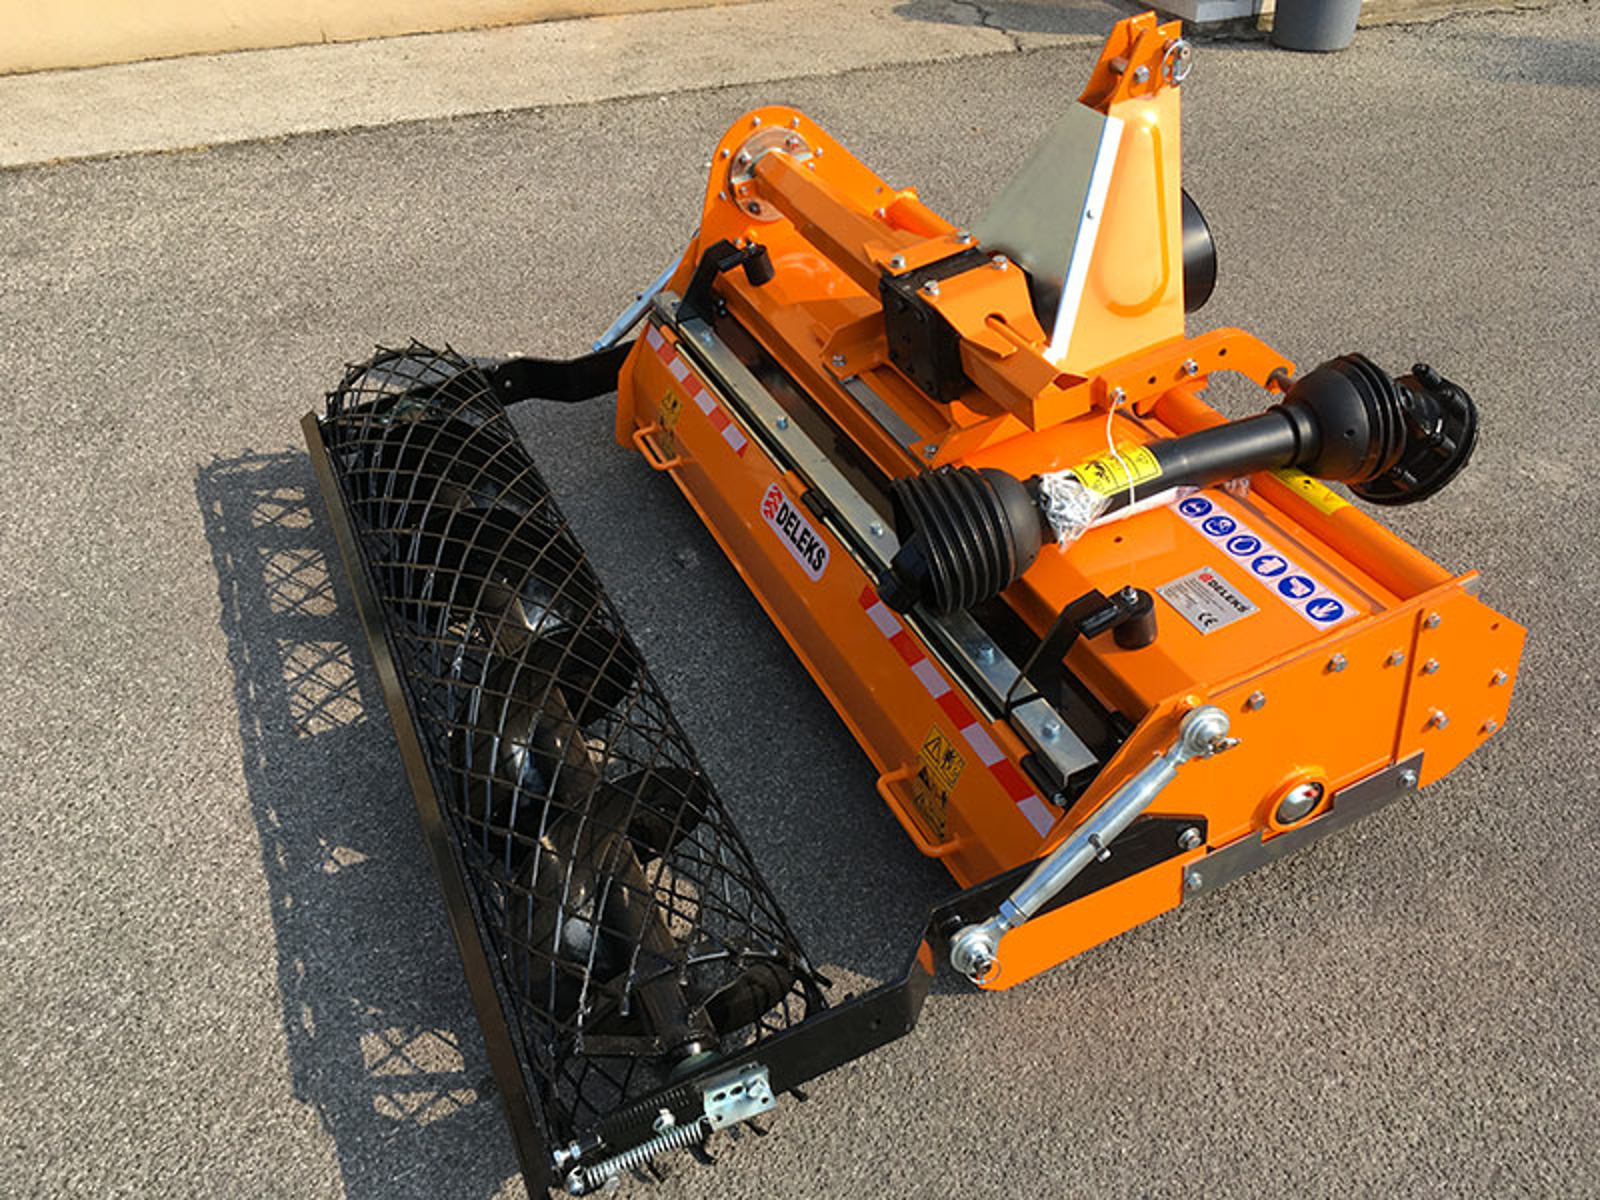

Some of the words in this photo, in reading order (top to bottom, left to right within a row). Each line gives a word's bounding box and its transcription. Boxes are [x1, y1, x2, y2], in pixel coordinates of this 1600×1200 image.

[775, 501, 826, 572] DELEKS
[1207, 579, 1250, 613] DELEKS
[1197, 612, 1219, 628] CE
